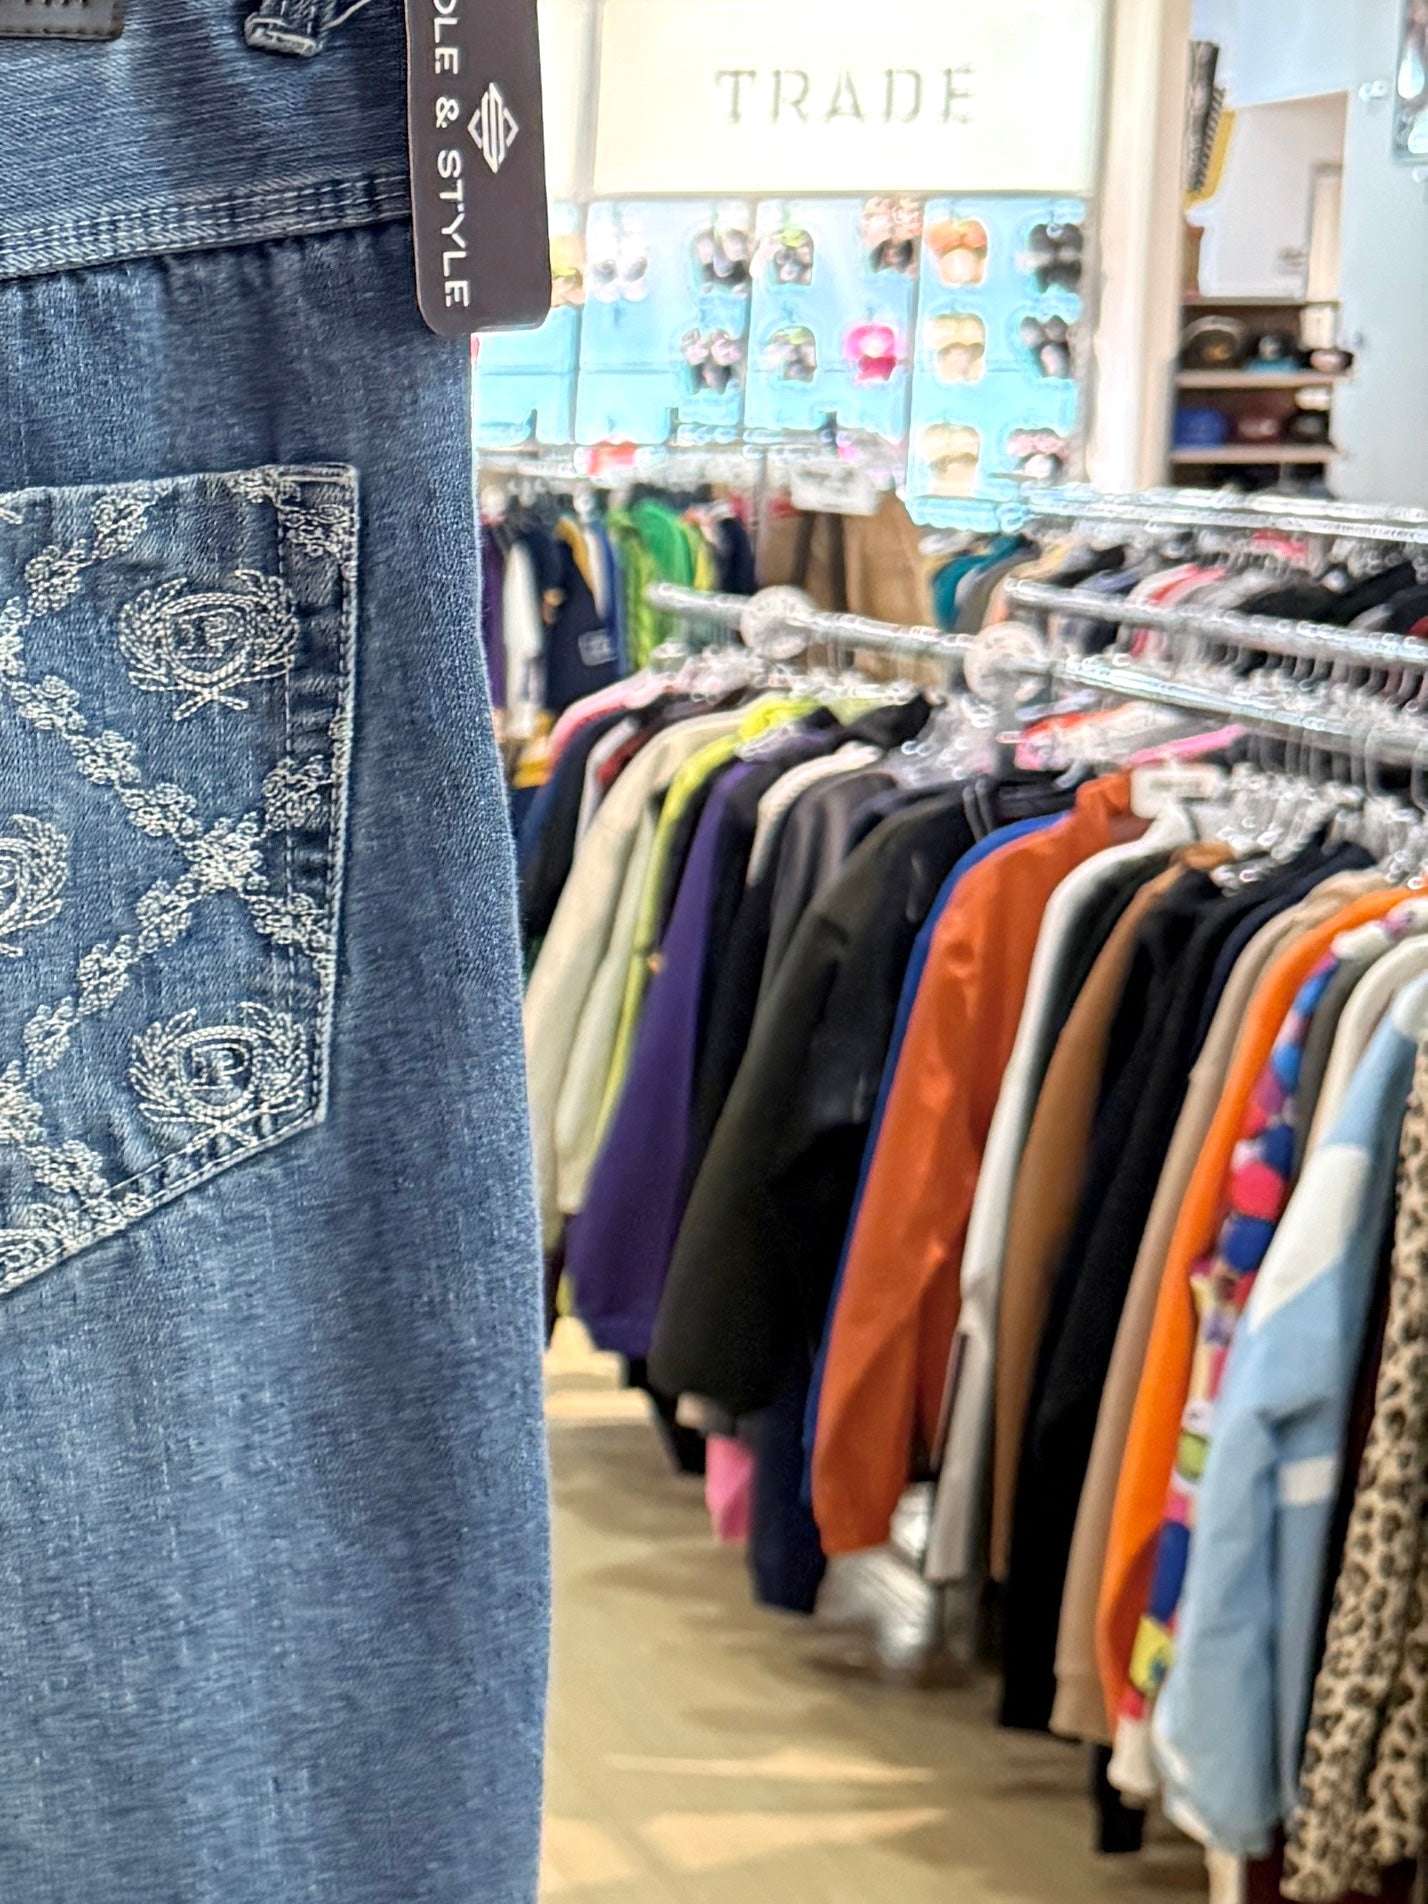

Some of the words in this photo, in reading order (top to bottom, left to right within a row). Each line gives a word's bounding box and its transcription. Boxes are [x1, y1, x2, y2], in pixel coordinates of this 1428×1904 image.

[435, 96, 460, 129] &
[714, 64, 976, 124] TRADE
[438, 149, 470, 308] STYLE
[190, 1042, 250, 1091] P
